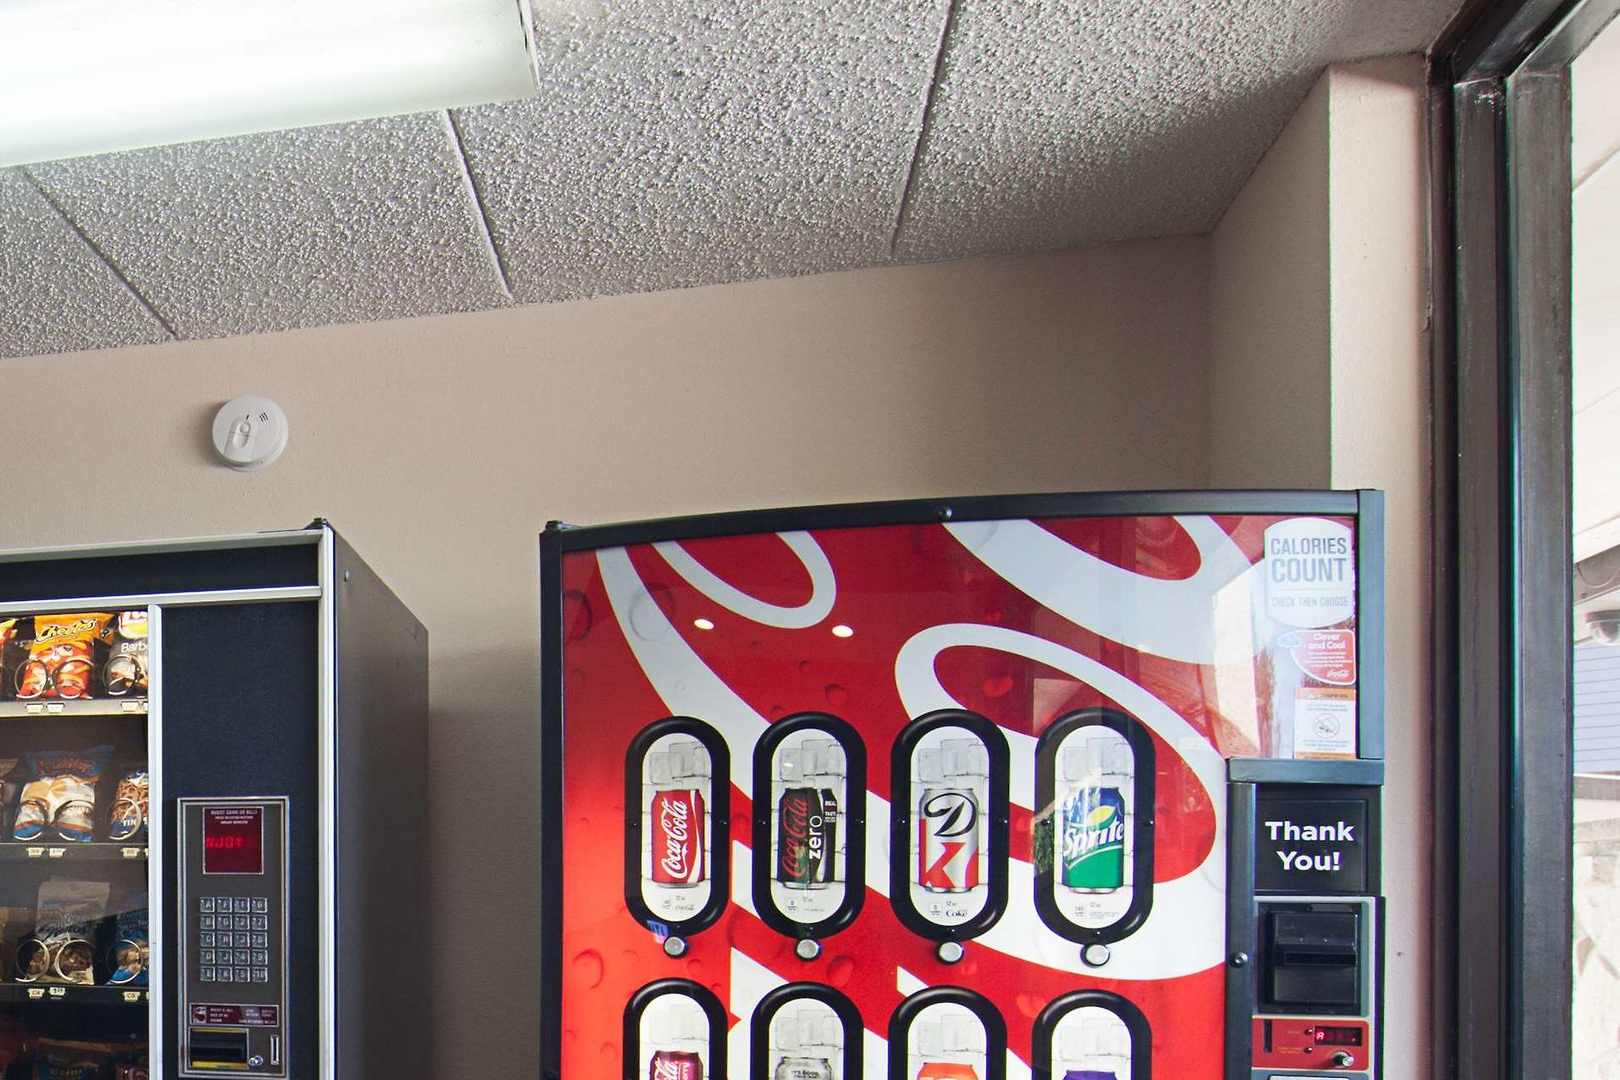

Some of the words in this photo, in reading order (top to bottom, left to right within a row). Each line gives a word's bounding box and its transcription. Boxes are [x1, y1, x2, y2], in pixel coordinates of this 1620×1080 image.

[1270, 537, 1348, 555] CALORIES
[1271, 558, 1347, 582] COUNT
[34, 618, 97, 643] Cheetos
[924, 792, 977, 837] D
[661, 796, 688, 879] Coca-Cola
[782, 796, 808, 878] Coca-Cola
[809, 815, 823, 860] zero
[1063, 816, 1124, 860] Sprite
[1264, 820, 1355, 842] Thank
[1276, 850, 1341, 871] You!
